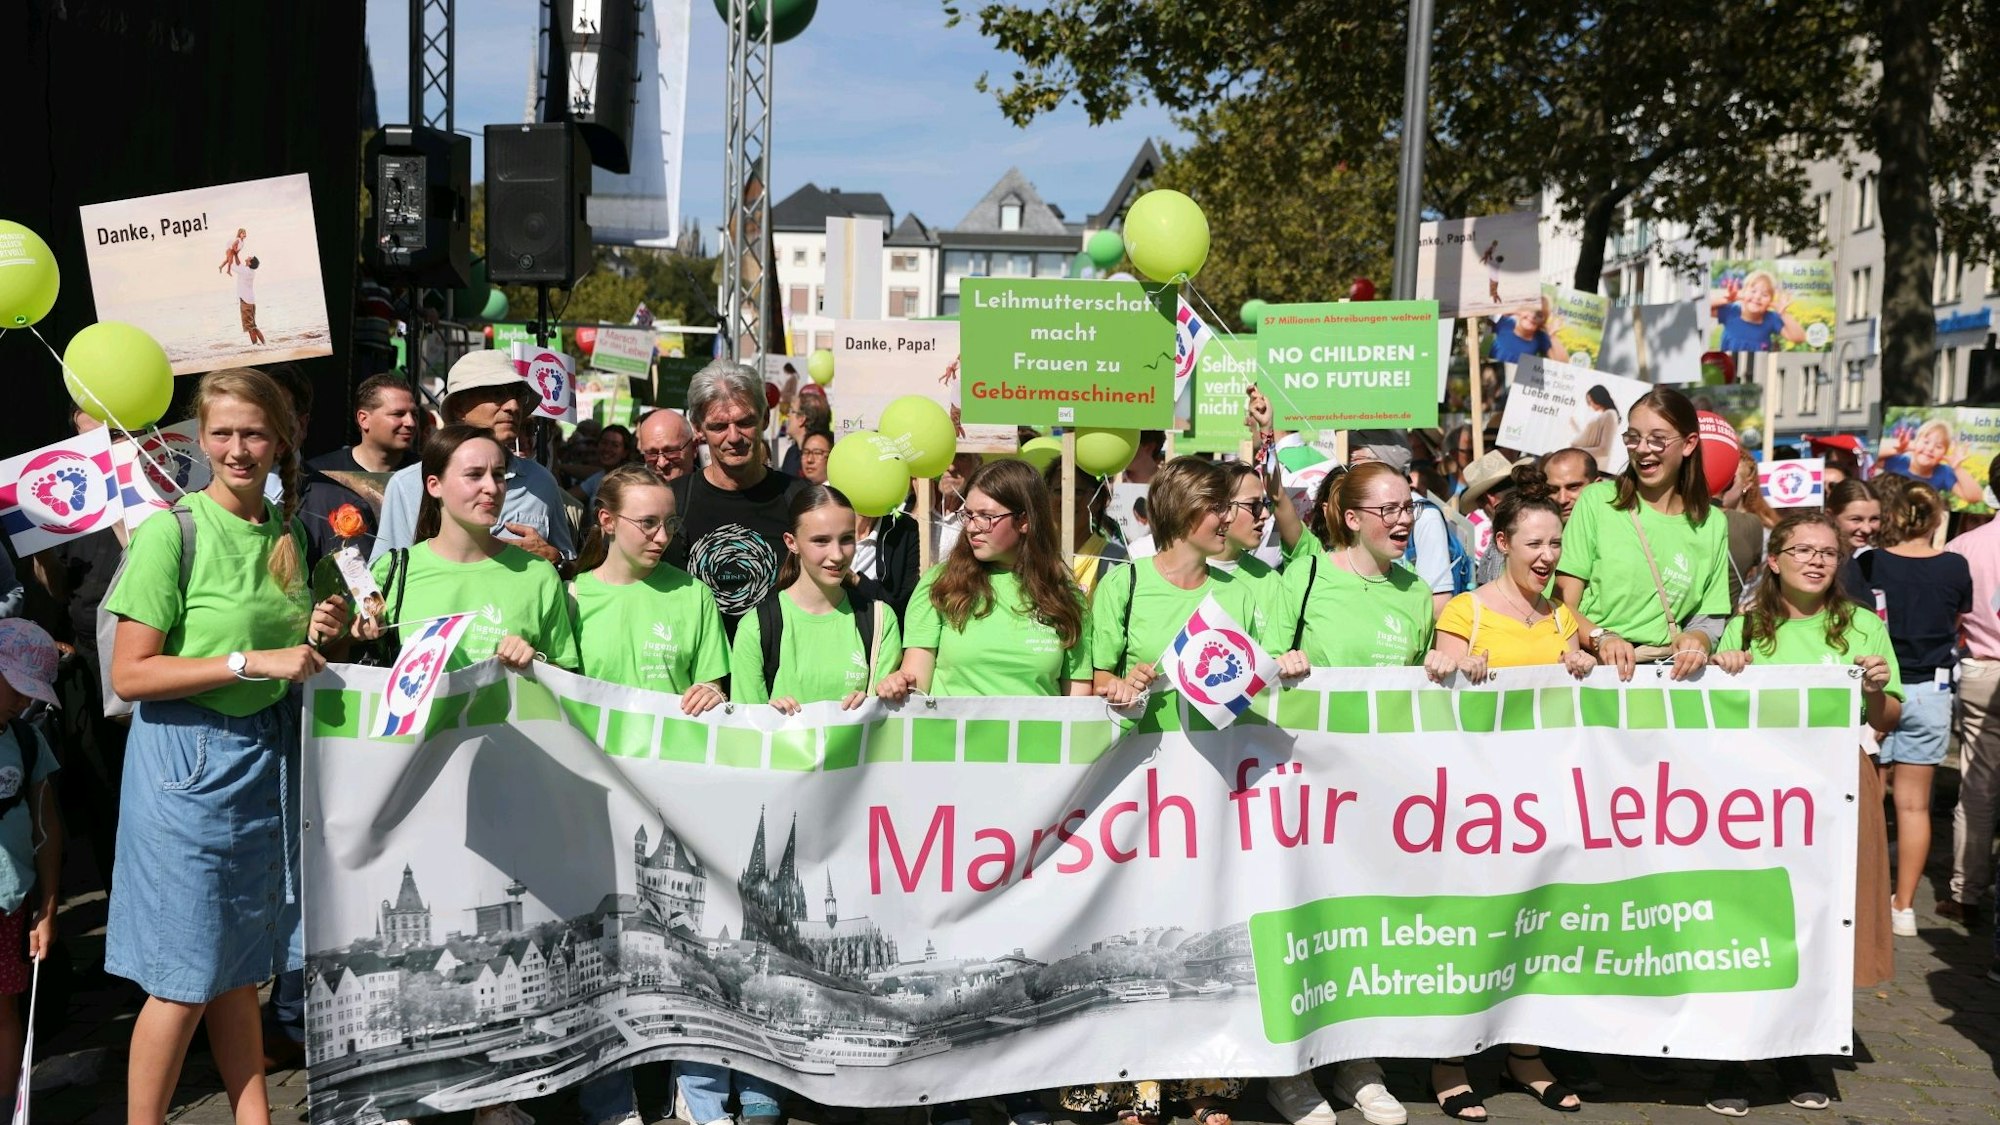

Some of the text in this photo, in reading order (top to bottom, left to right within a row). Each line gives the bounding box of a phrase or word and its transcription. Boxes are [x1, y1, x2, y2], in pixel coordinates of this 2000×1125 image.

[97, 212, 208, 246] Danke, Papa!
[1418, 231, 1476, 247] anke, Papa!
[1264, 313, 1432, 325] 57 Millionen Abtreibungen weltweit
[604, 329, 638, 345] Marsch
[1030, 322, 1097, 341] macht
[845, 337, 936, 354] Danke, Papa!
[1268, 346, 1303, 364] NO
[1310, 344, 1415, 363] CHILDREN
[1013, 351, 1121, 373] Frauen zu
[1202, 354, 1257, 373] Selbstt
[1204, 375, 1247, 394] verhi
[1284, 370, 1411, 389] NO FUTURE!
[971, 381, 1156, 404] Gebärmaschinen!
[1521, 384, 1576, 407] Liebe mich
[1198, 397, 1239, 415] nicht
[1531, 403, 1561, 418] auch!
[1960, 431, 2000, 443] besond
[643, 640, 679, 653] Jugend
[1376, 630, 1408, 644] Jugend
[845, 670, 866, 681] Juge
[868, 758, 1816, 895] Marsch für das Leben
[1283, 931, 1309, 965] Ja
[1313, 926, 1369, 955] zum
[1381, 913, 1478, 946] Leben
[1514, 907, 1551, 938] für
[1560, 903, 1610, 932] ein
[1621, 899, 1715, 933] Europa
[1290, 937, 1773, 1017] ohne Abtreibung und Euthanasie!
